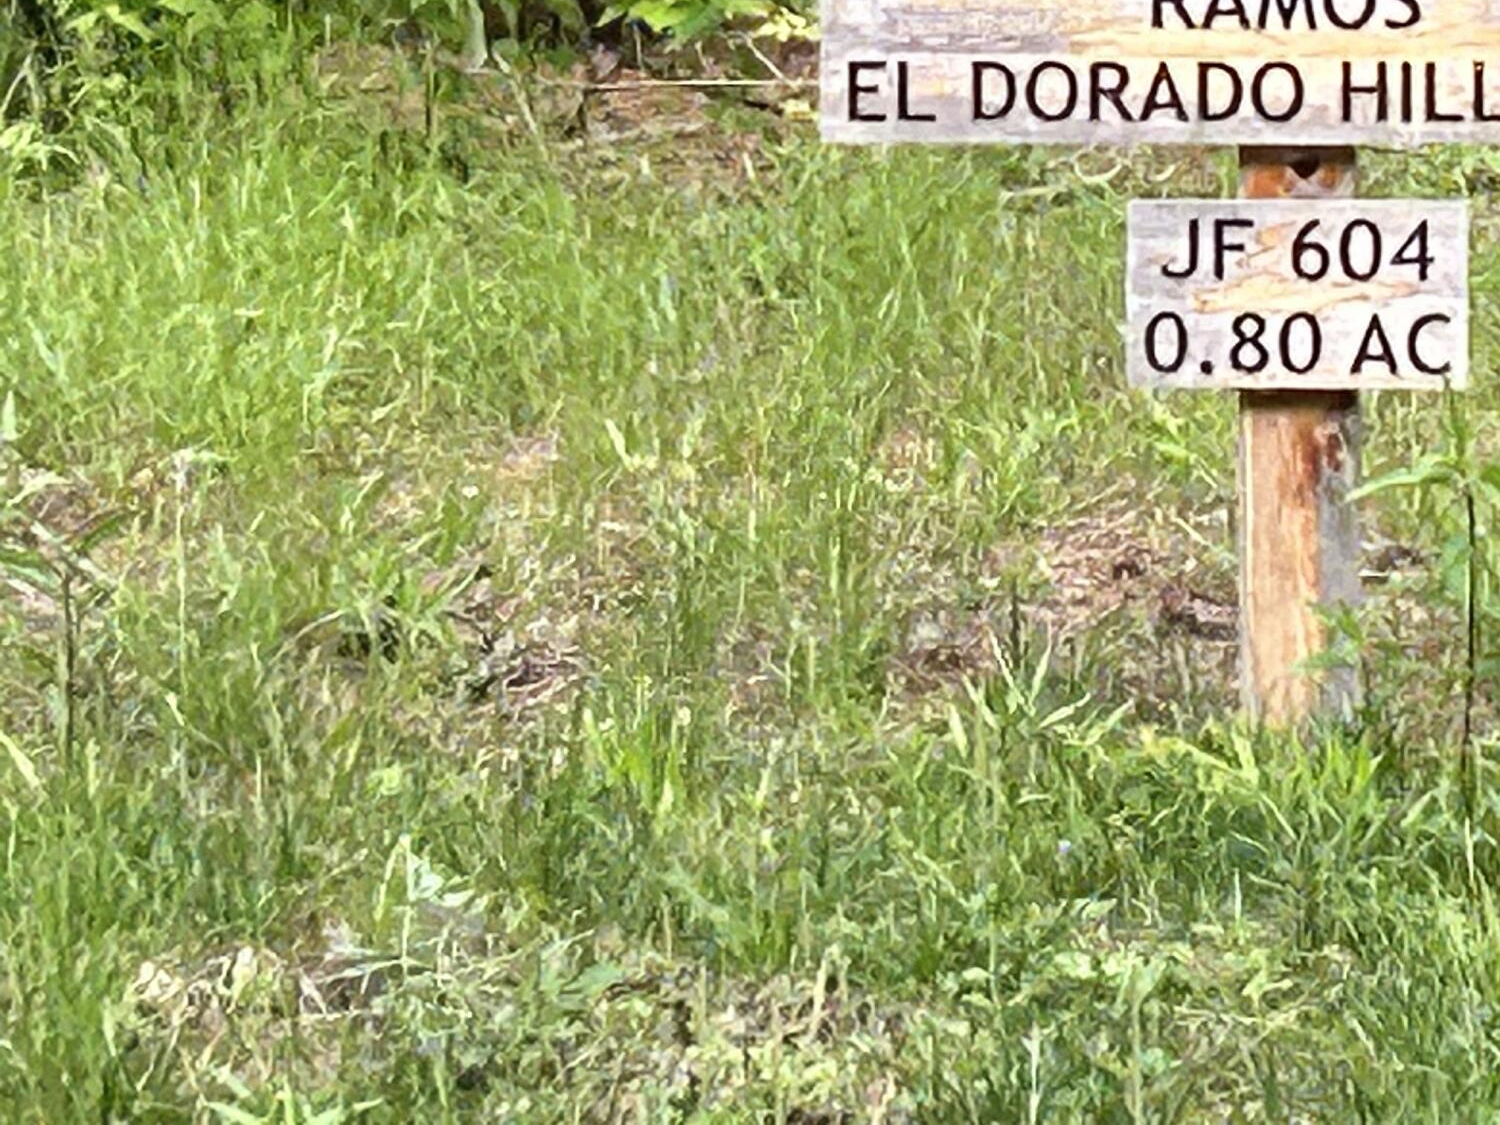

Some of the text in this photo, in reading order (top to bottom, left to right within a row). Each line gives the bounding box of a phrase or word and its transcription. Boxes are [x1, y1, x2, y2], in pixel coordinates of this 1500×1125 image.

[848, 61, 937, 122] EL
[971, 61, 1304, 123] DORADO
[1161, 218, 1435, 282] JF 604
[1144, 311, 1451, 375] 0.80 AC
